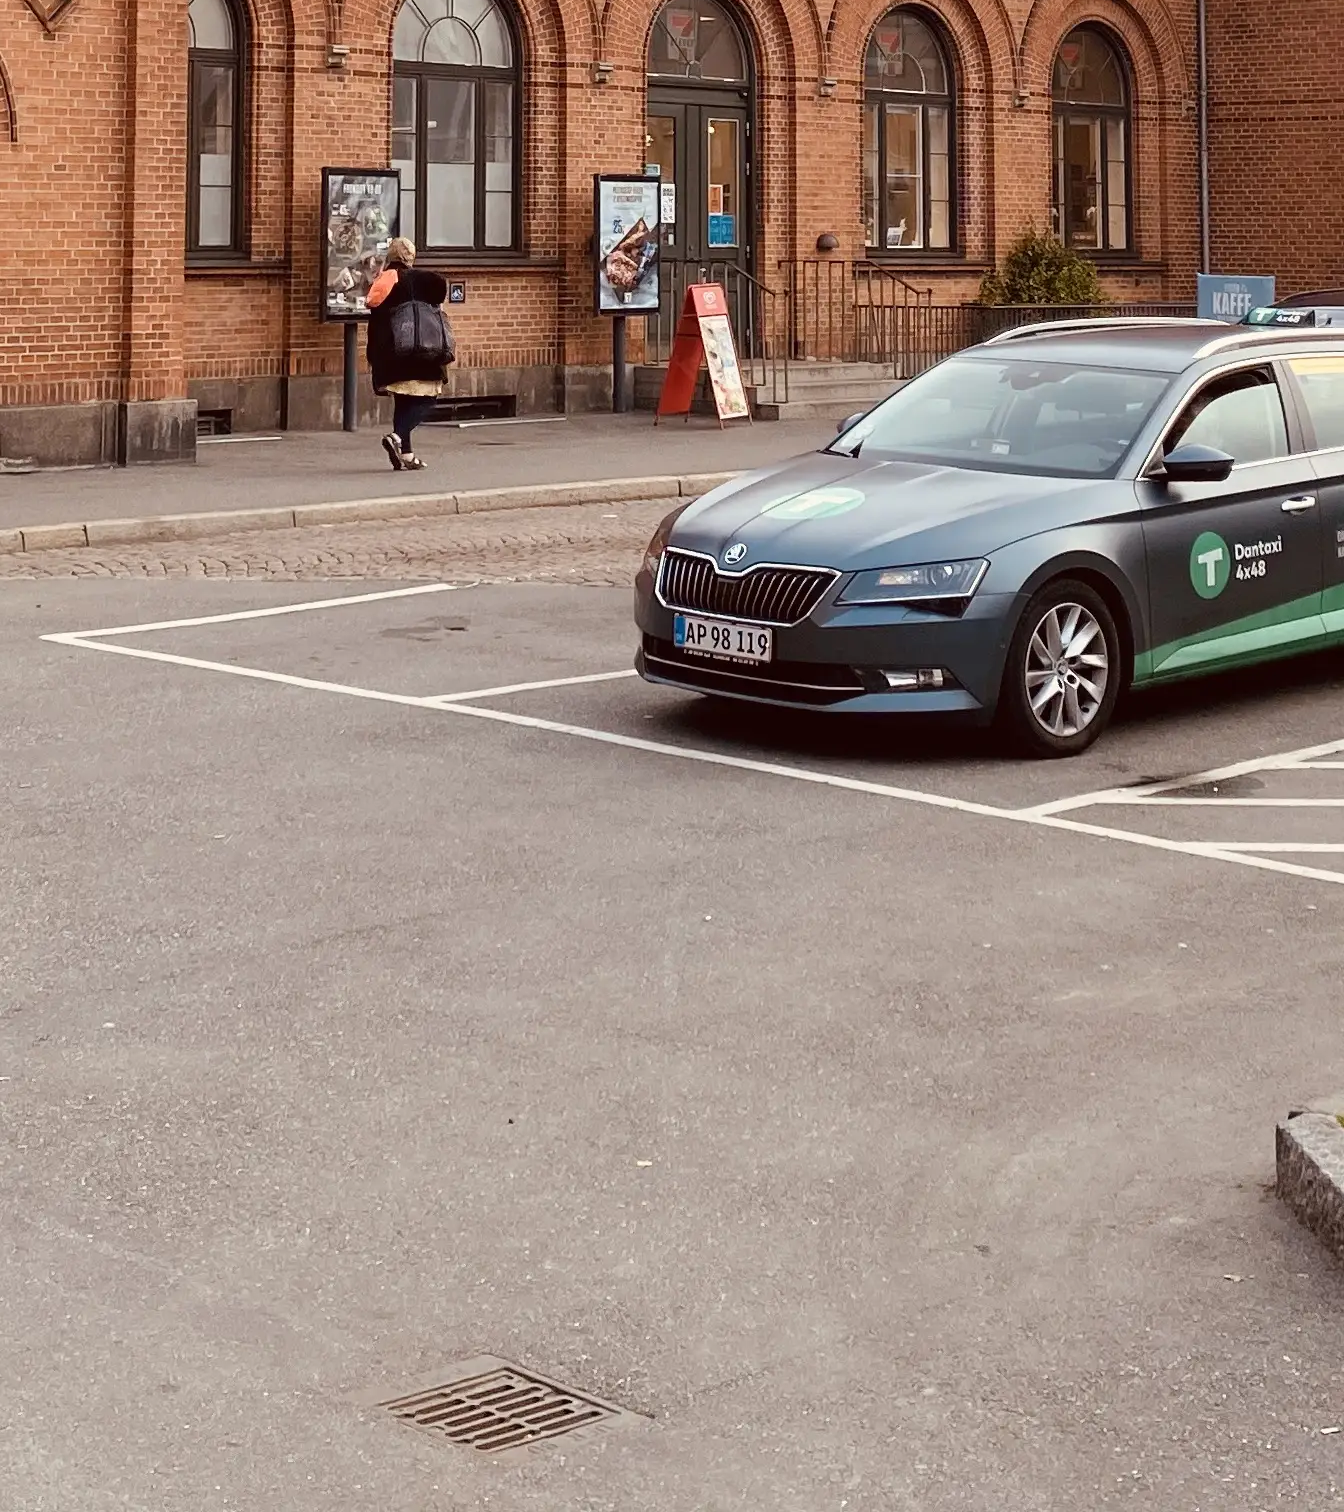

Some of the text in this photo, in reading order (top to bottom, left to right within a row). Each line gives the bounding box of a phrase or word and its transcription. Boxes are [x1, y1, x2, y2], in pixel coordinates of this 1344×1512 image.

[1234, 535, 1283, 561] Dantaxi
[1198, 548, 1223, 587] T
[1236, 560, 1266, 581] 4x48
[685, 622, 768, 656] AP 98 119
